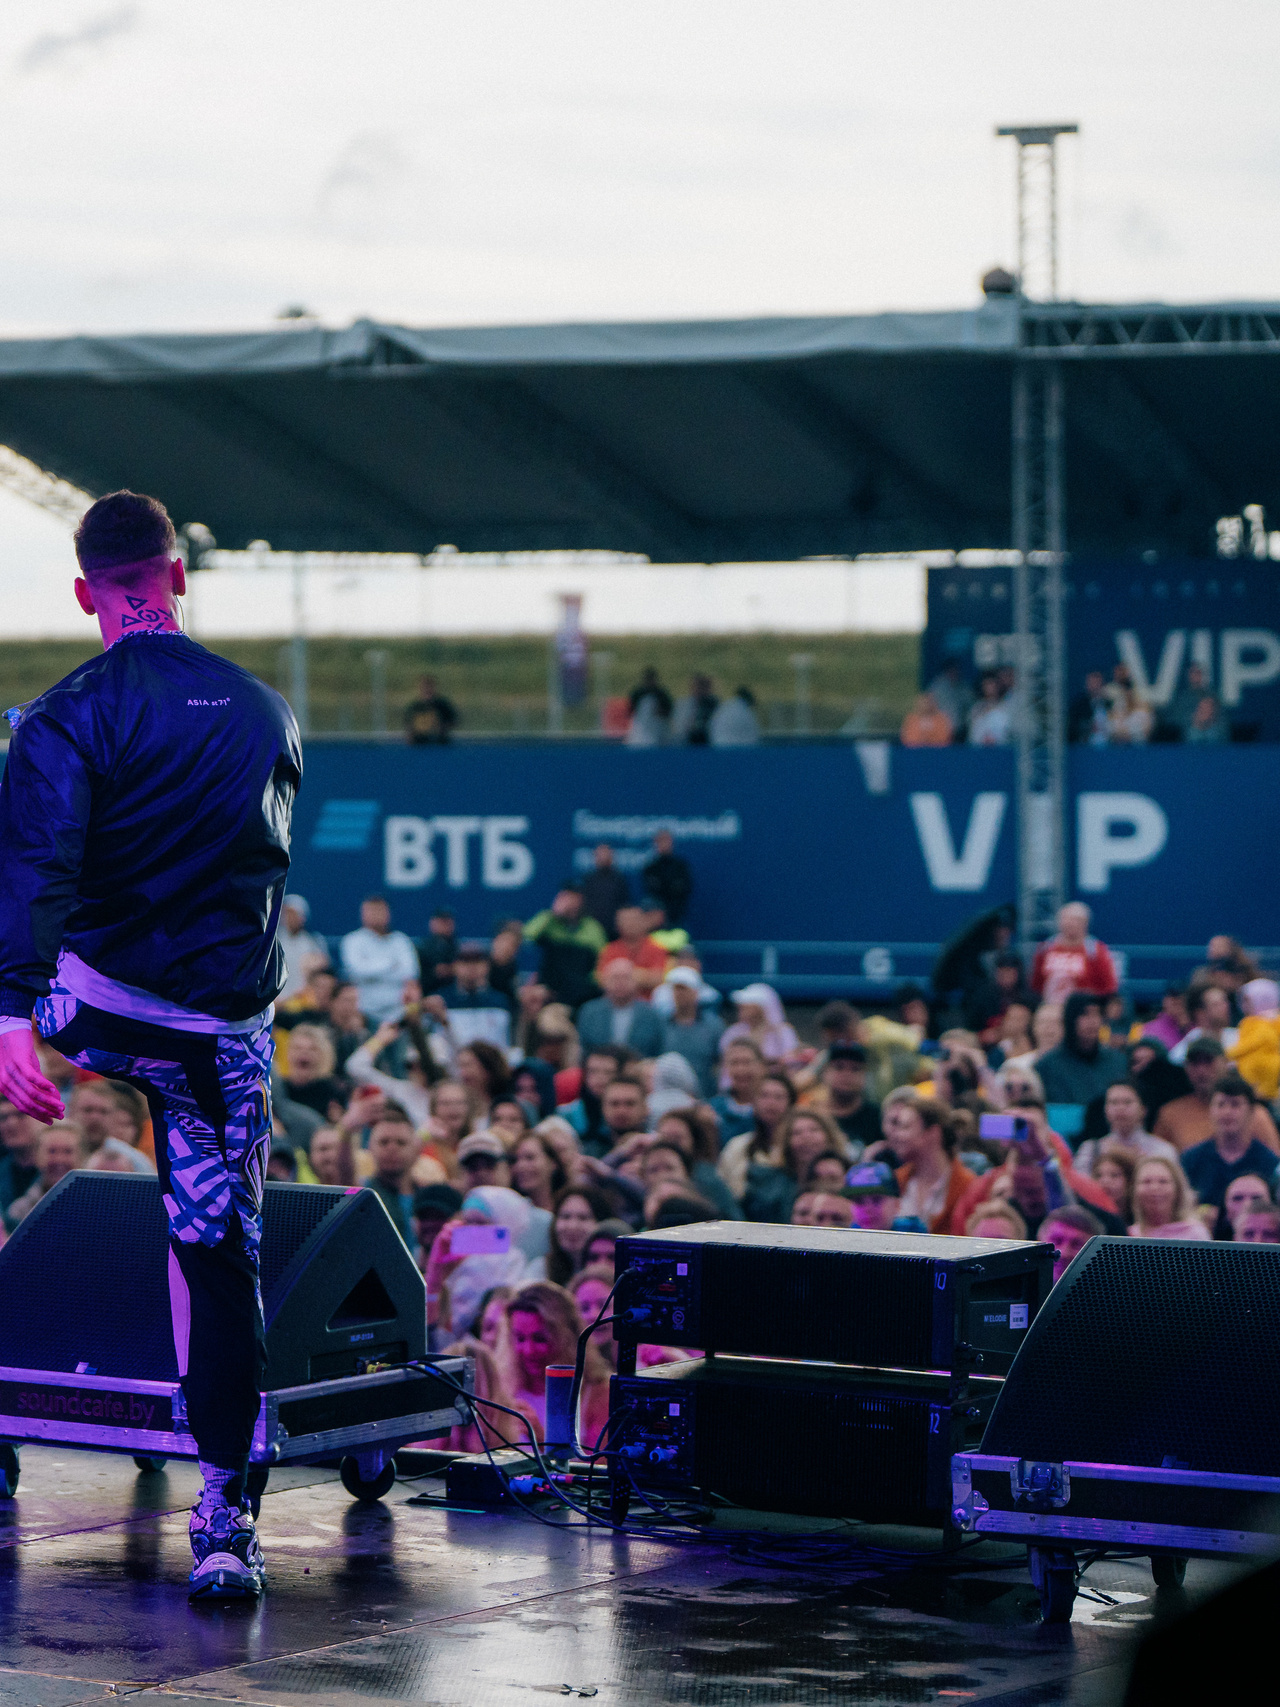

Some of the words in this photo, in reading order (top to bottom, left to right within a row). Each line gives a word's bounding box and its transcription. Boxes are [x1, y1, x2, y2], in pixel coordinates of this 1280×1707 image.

[1114, 628, 1280, 706] VIP
[384, 815, 534, 888] ВТБ
[909, 791, 1169, 892] VIP
[934, 1272, 947, 1291] 10
[18, 1390, 155, 1429] soundcafe.by
